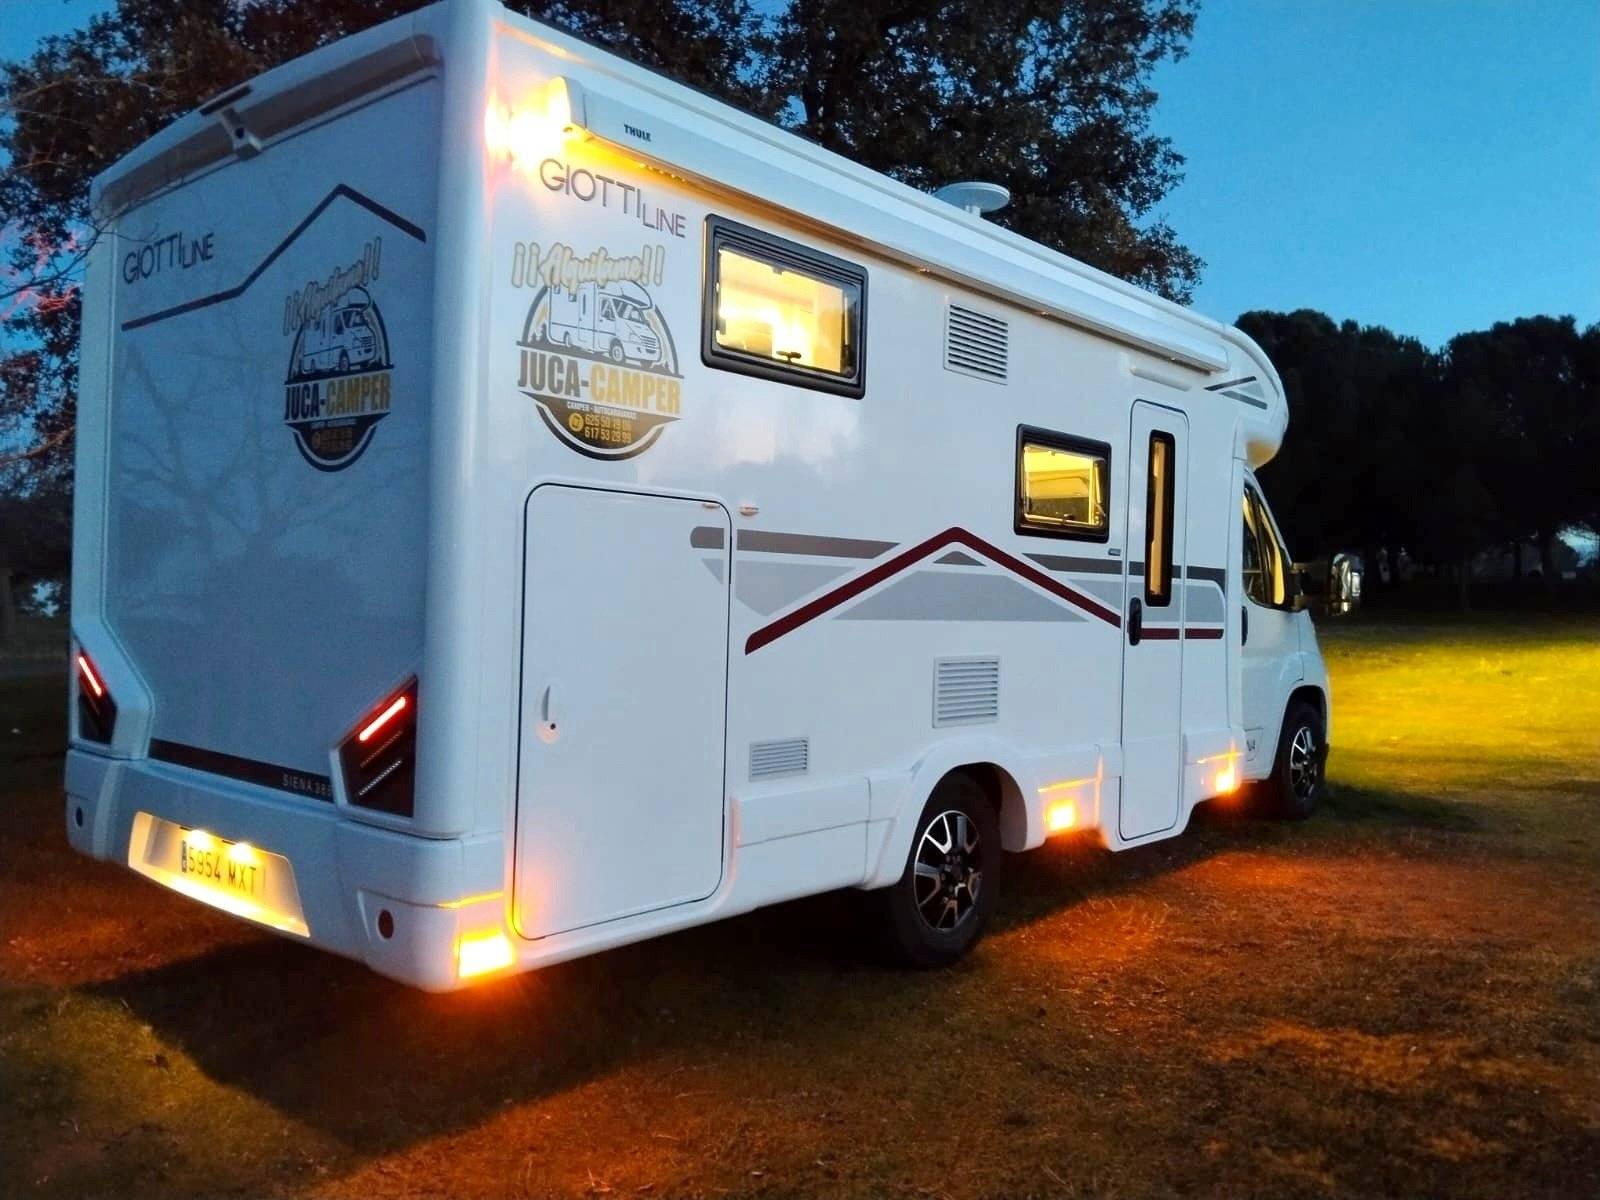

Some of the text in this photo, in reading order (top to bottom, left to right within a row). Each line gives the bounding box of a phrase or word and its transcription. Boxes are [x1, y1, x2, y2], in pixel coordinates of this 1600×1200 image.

[623, 123, 652, 143] THULE
[517, 349, 682, 415] JUCA-CAMPER
[284, 372, 391, 420] JUCA-CAMPER
[584, 427, 600, 439] 617
[282, 773, 313, 792] SIENA
